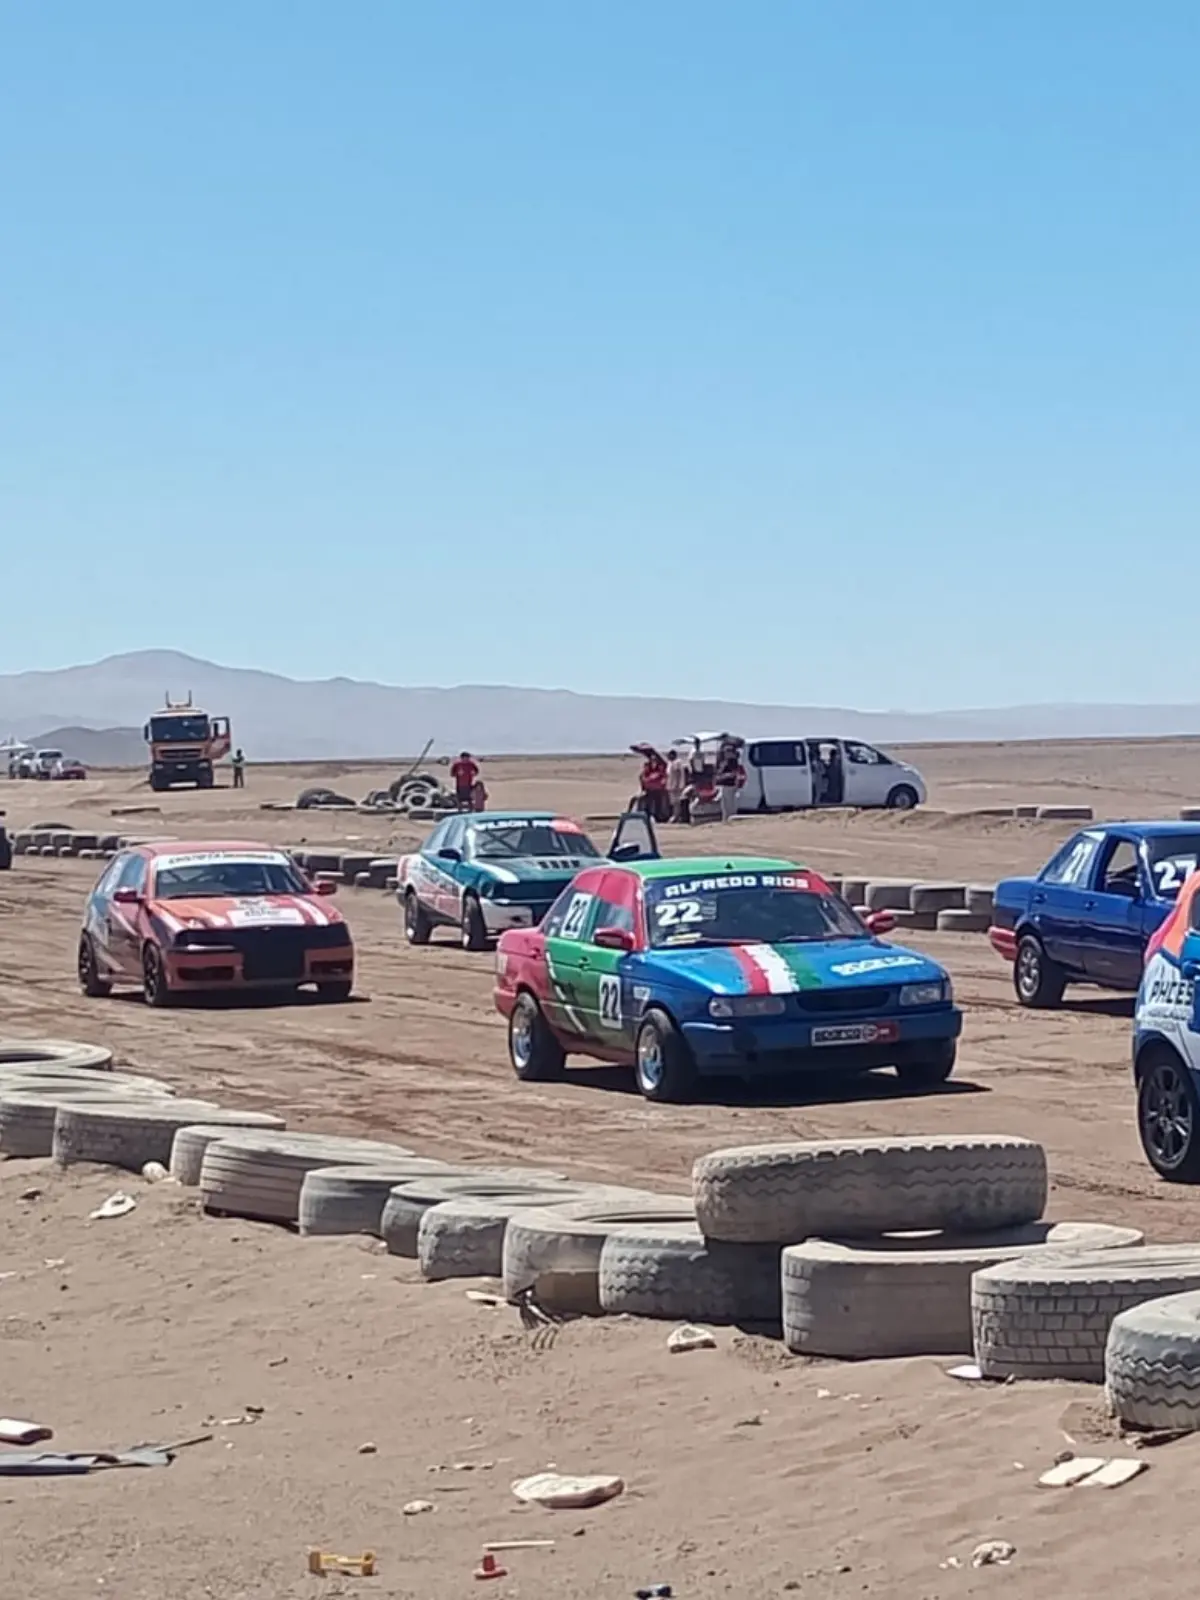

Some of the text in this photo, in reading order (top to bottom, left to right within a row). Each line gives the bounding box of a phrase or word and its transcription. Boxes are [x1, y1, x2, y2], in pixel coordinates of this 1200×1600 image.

[665, 875, 809, 898] ALFREDO RIOS
[655, 901, 703, 927] 22
[600, 980, 619, 1022] 22
